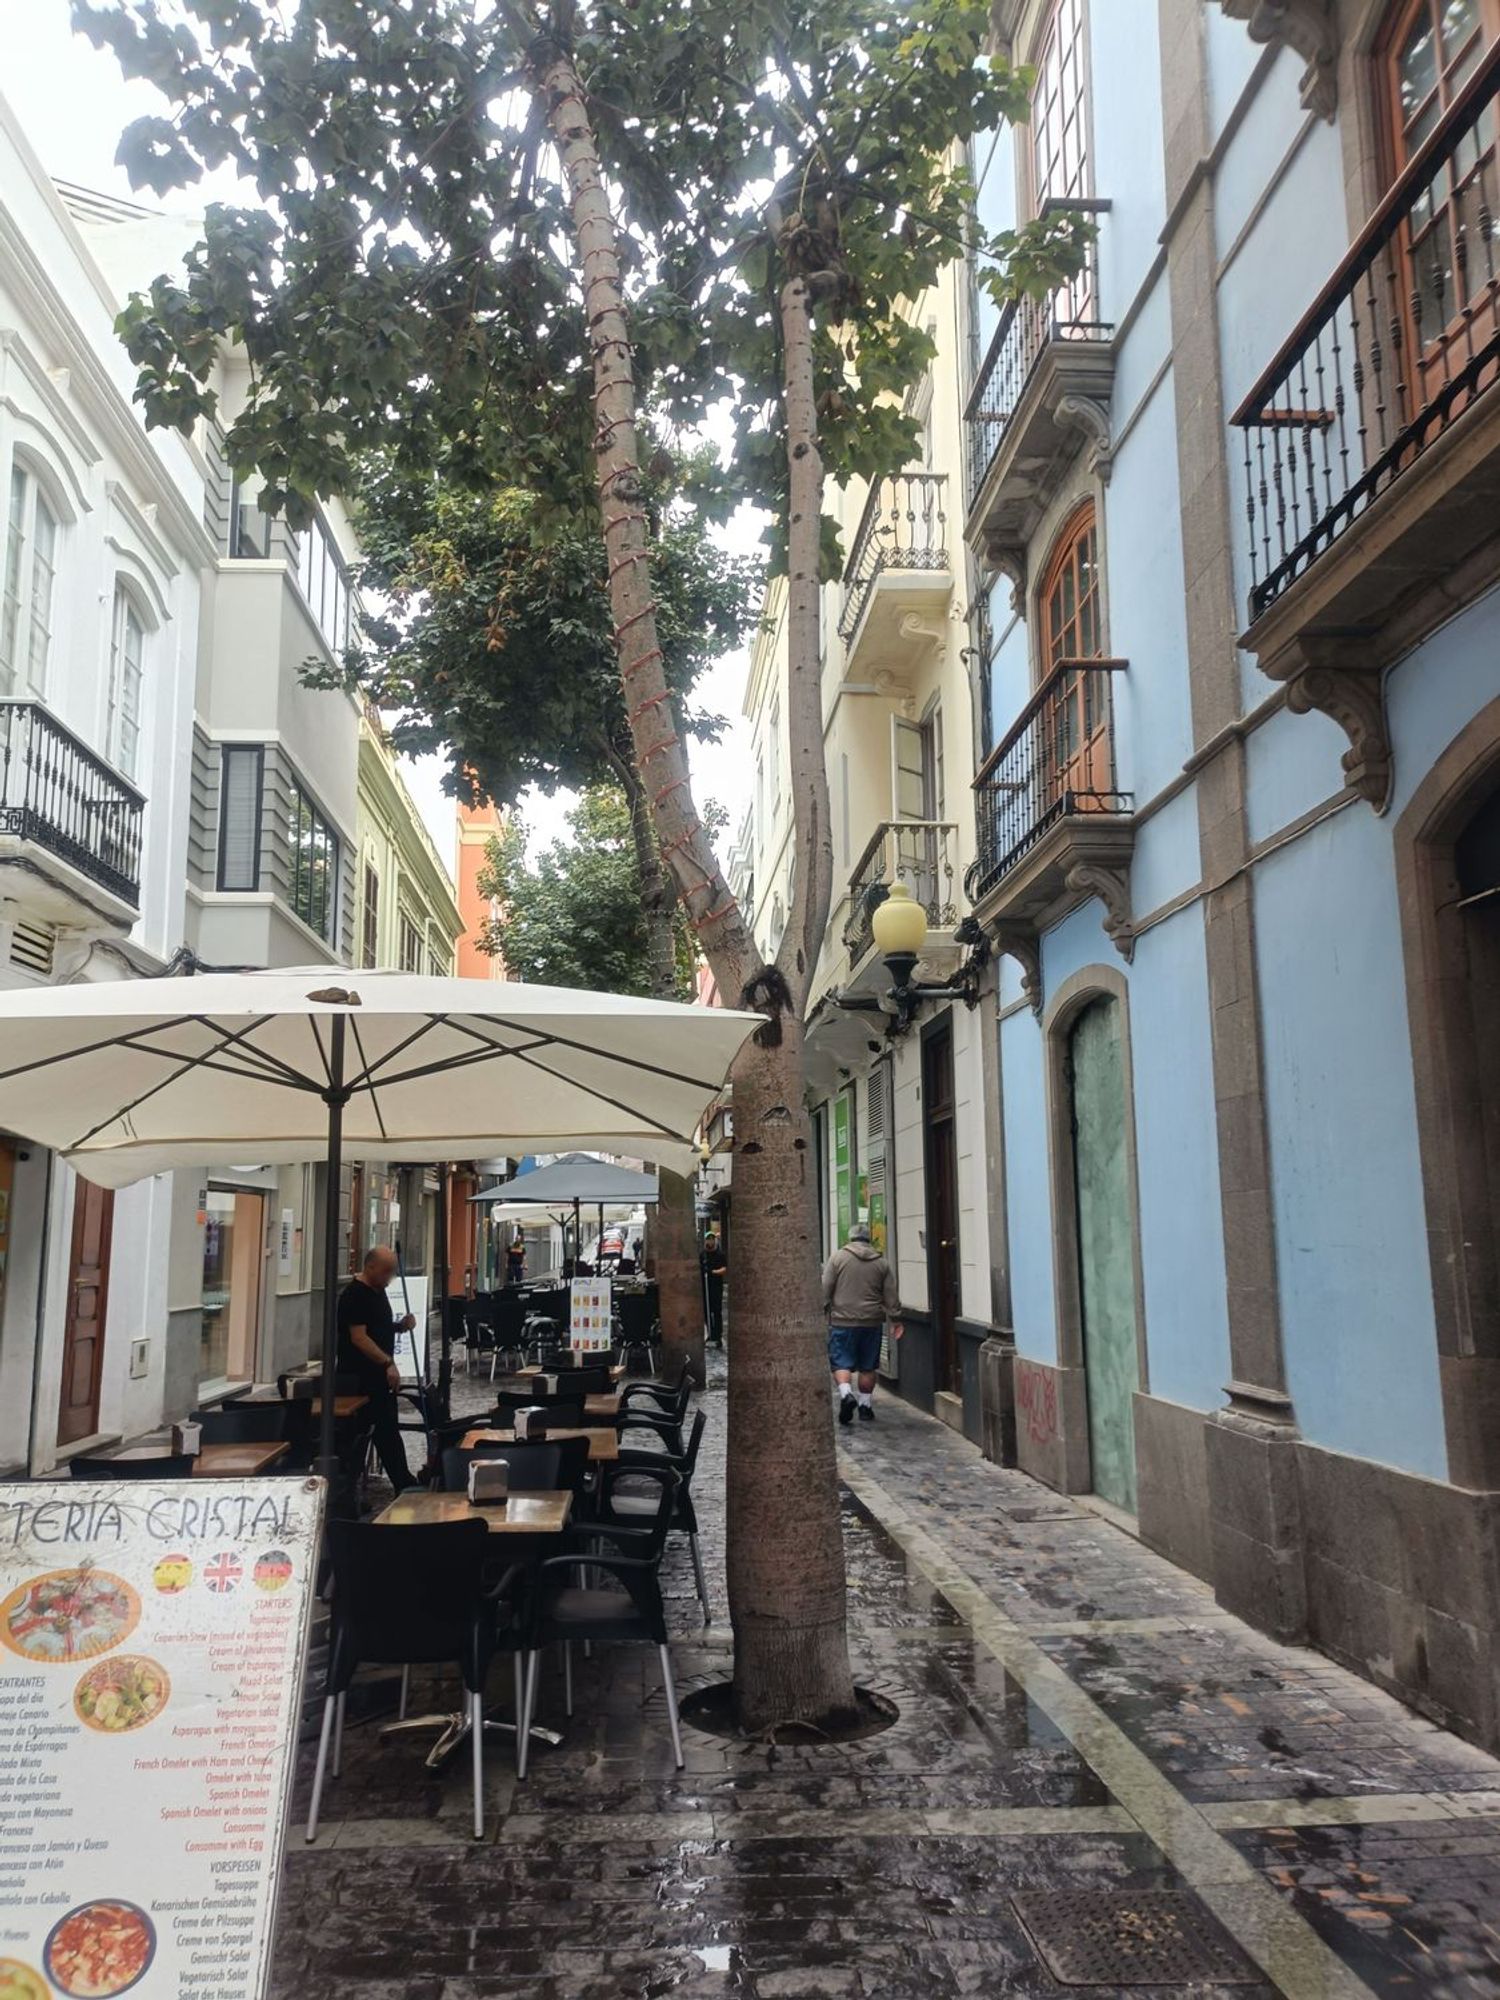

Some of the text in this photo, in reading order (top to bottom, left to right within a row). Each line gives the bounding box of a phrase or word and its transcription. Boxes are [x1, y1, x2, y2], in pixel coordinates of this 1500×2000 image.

[146, 1495, 299, 1540] CRISTAL
[255, 1598, 293, 1610] STARTERS
[209, 1646, 234, 1657] Cream
[211, 1661, 236, 1672] Cream
[17, 1694, 30, 1703] del
[19, 1709, 49, 1719] Canario
[216, 1708, 257, 1722] Vegetarian
[16, 1724, 26, 1735] de
[171, 1726, 212, 1737] Asparagus
[213, 1724, 231, 1734] with
[13, 1742, 23, 1751] de
[220, 1738, 276, 1750] French Omelet
[20, 1757, 42, 1767] Mixta
[134, 1759, 160, 1769] French
[161, 1757, 190, 1768] Omelet
[191, 1756, 208, 1767] with
[210, 1756, 229, 1767] Ham
[230, 1755, 245, 1765] and
[16, 1774, 27, 1784] de
[28, 1773, 37, 1784] la
[39, 1772, 57, 1783] Casa
[206, 1772, 234, 1783] Omelet
[235, 1771, 252, 1781] with
[14, 1792, 61, 1804] vegetariana
[209, 1787, 270, 1800] Spanish Omelet
[17, 1810, 32, 1818] con
[33, 1807, 73, 1819] Mayonesa
[160, 1804, 268, 1819] Spanish Omelet with onions
[32, 1843, 46, 1852] con
[47, 1841, 75, 1852] Jamón
[83, 1839, 109, 1850] Queso
[229, 1840, 247, 1850] with
[248, 1838, 264, 1851] Egg
[28, 1861, 43, 1869] con
[44, 1858, 64, 1869] Atún
[210, 1860, 262, 1873] VORSPEISEN
[214, 1879, 259, 1893] Tagessuppe
[24, 1896, 38, 1904] con
[40, 1892, 71, 1904] Cebolla
[151, 1896, 257, 1911] Kanarischen Gemüsebrühe
[172, 1914, 255, 1928] Creme der Pilzsuppe
[176, 1931, 253, 1946] Creme von Spargel
[190, 1949, 251, 1964] Gemischt Salat
[179, 1968, 248, 1984] Vegetarisch Salat
[177, 1986, 246, 2000] Salat des Hauses
